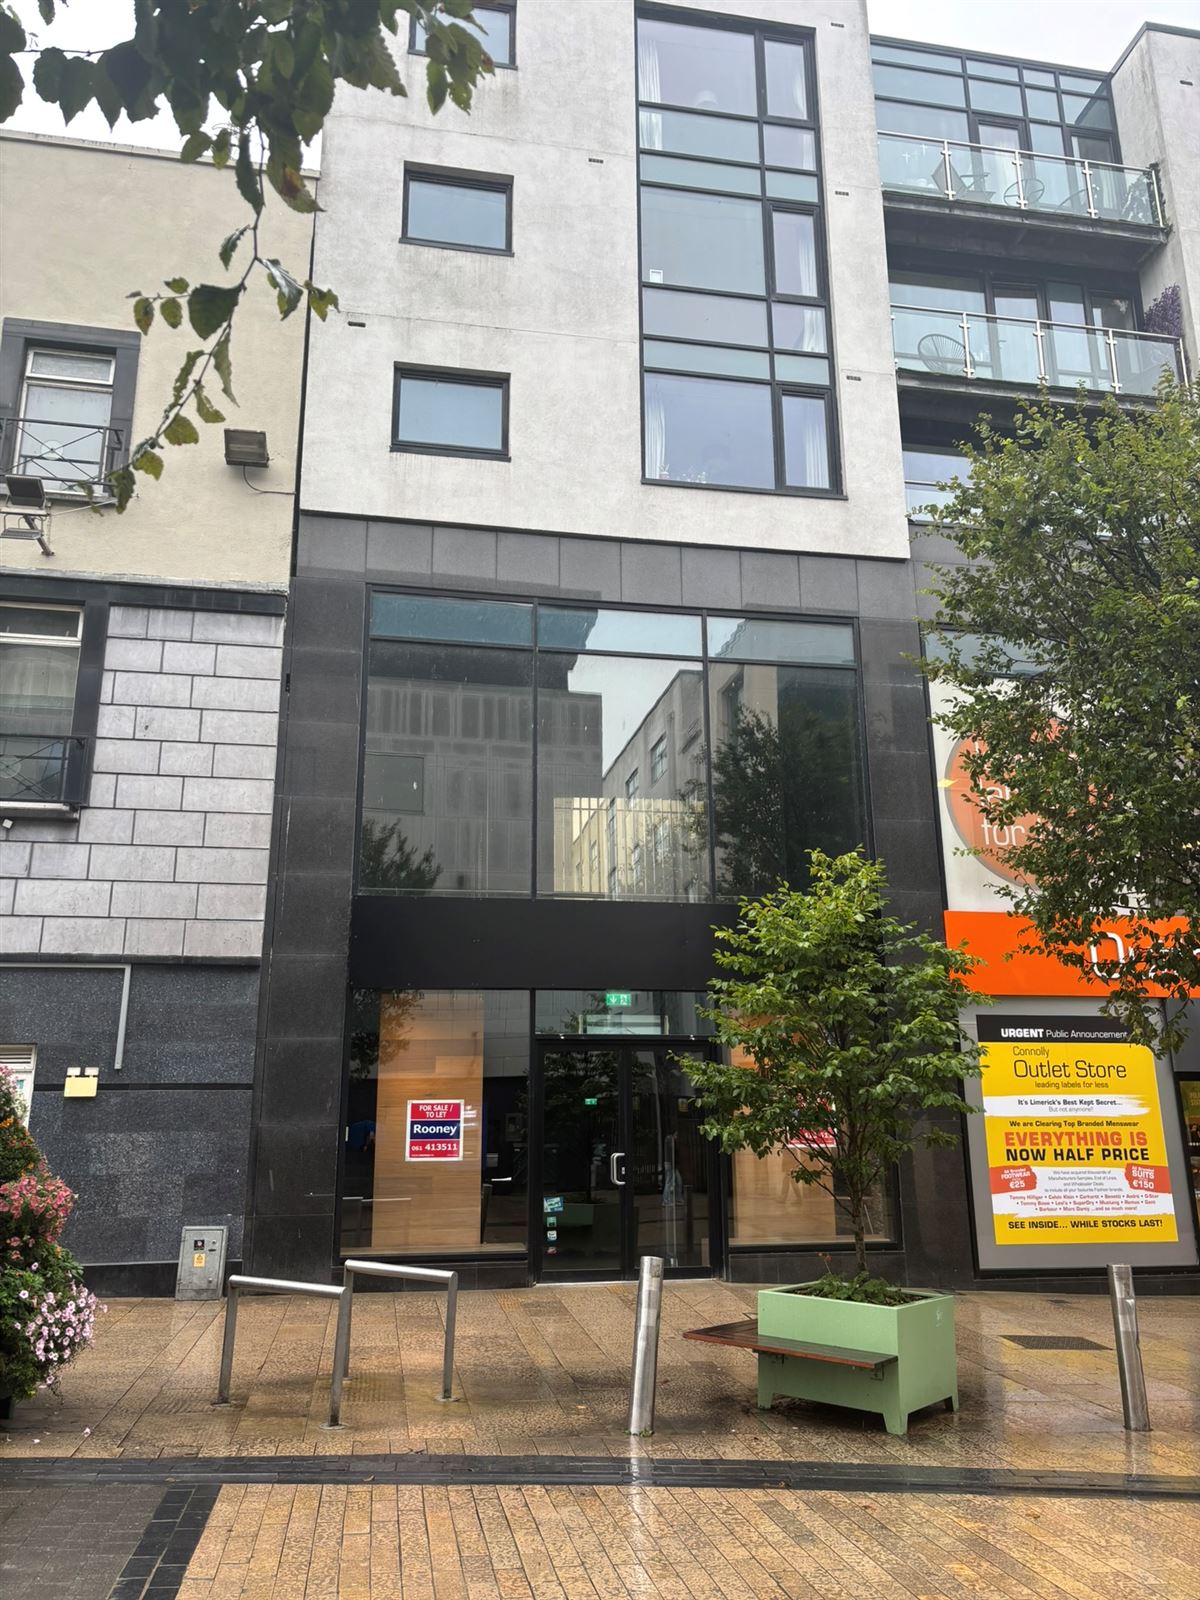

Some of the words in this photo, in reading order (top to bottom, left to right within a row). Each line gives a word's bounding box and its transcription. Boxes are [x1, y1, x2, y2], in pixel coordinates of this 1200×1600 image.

[1001, 1028, 1044, 1038] URGENT
[1045, 1029, 1069, 1038] Public
[1070, 1029, 1128, 1039] Announcement
[1012, 1046, 1050, 1059] Connolly
[1013, 1059, 1071, 1078] Outlet
[1075, 1059, 1127, 1078] Store
[1034, 1081, 1060, 1090] leading
[419, 1104, 432, 1112] FOR
[433, 1104, 449, 1112] SALE
[1079, 1099, 1095, 1107] Kept
[1035, 1120, 1062, 1128] Clearing
[1063, 1120, 1076, 1128] Top
[413, 1124, 458, 1136] Rooney
[1004, 1131, 1123, 1147] EVERYTHING
[1129, 1131, 1148, 1146] IS
[424, 1143, 458, 1151] 413511
[1006, 1148, 1046, 1161] NOW
[1053, 1148, 1094, 1161] HALF
[1101, 1148, 1150, 1161] PRICE
[1001, 1171, 1031, 1180] FOOTWEAR
[1131, 1169, 1155, 1179] SUITS
[1009, 1180, 1026, 1189] €25
[1132, 1179, 1155, 1189] €150
[1008, 1221, 1026, 1229] SEE
[1028, 1221, 1068, 1229] INSIDE...
[1070, 1220, 1099, 1228] WHILE
[1101, 1220, 1137, 1228] STOCKS
[1138, 1219, 1163, 1227] LAST!
